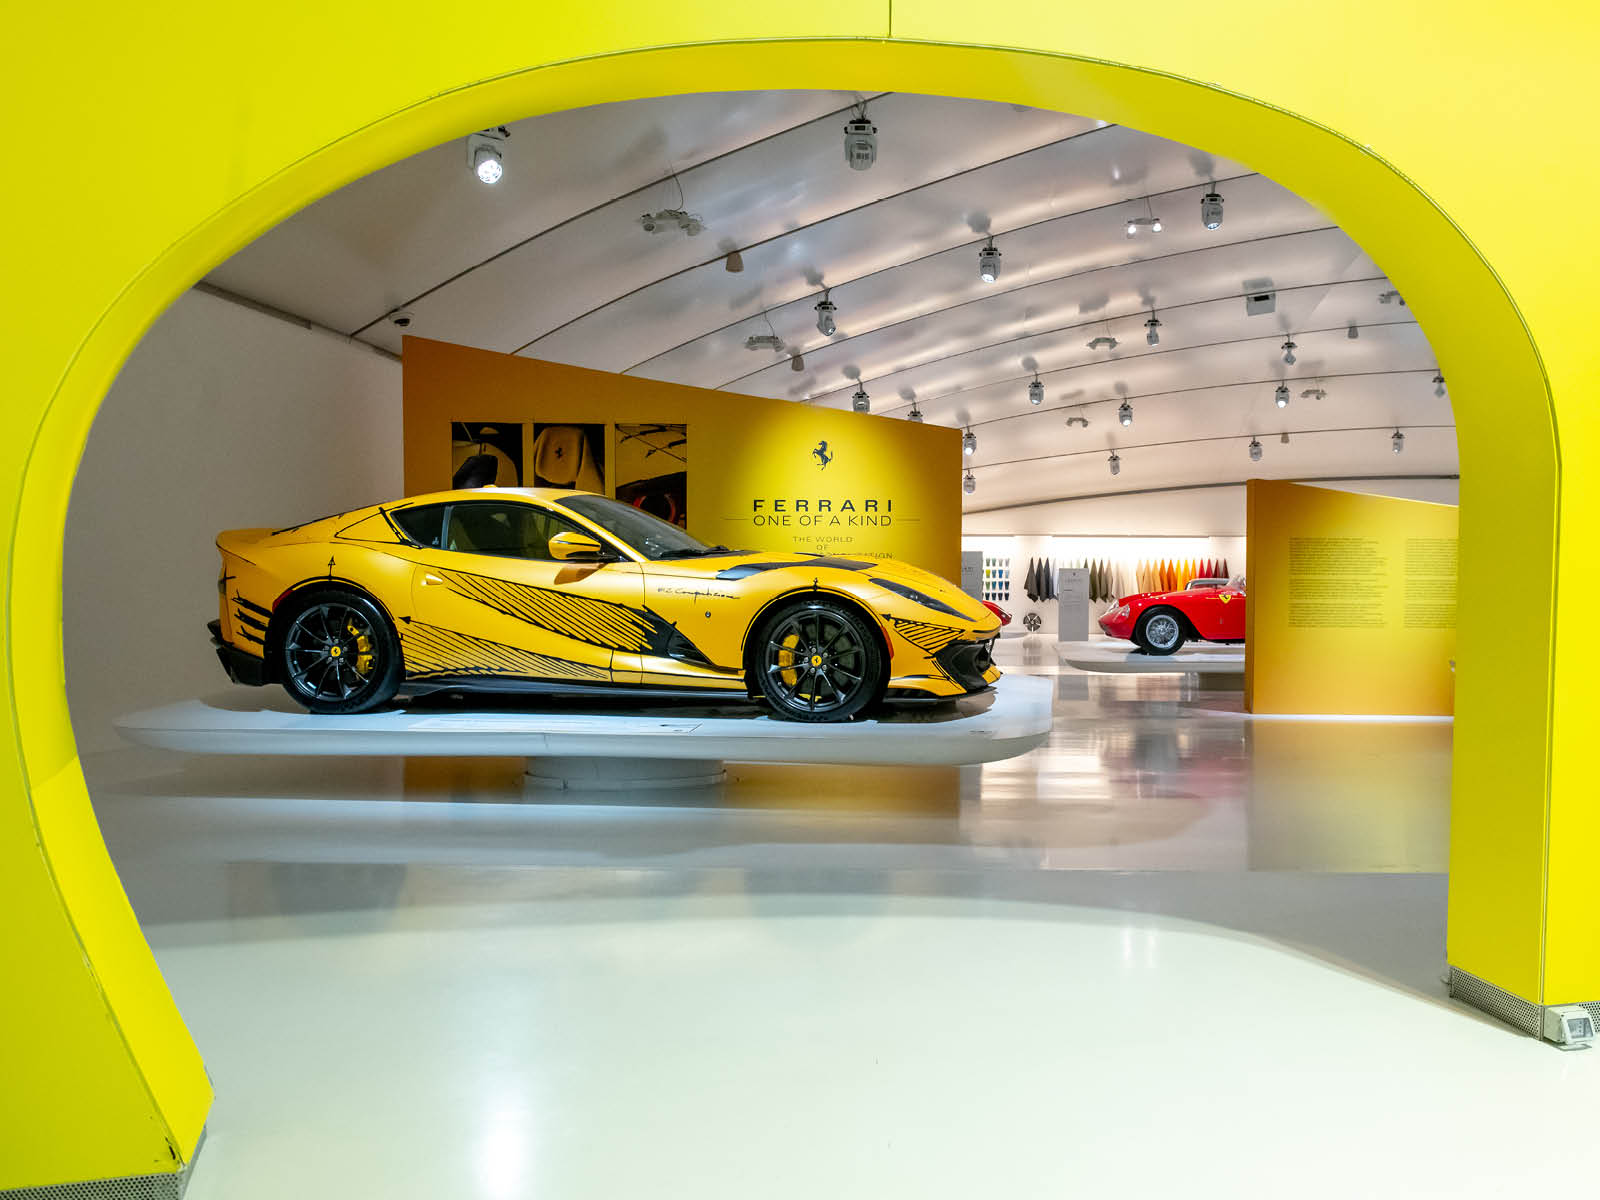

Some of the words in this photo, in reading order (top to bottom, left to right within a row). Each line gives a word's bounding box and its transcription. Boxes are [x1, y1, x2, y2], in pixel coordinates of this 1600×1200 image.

[753, 499, 892, 512] FERRARI
[753, 515, 792, 526] ONE
[799, 515, 824, 526] OF
[829, 515, 841, 526] A
[848, 515, 892, 526] KIND
